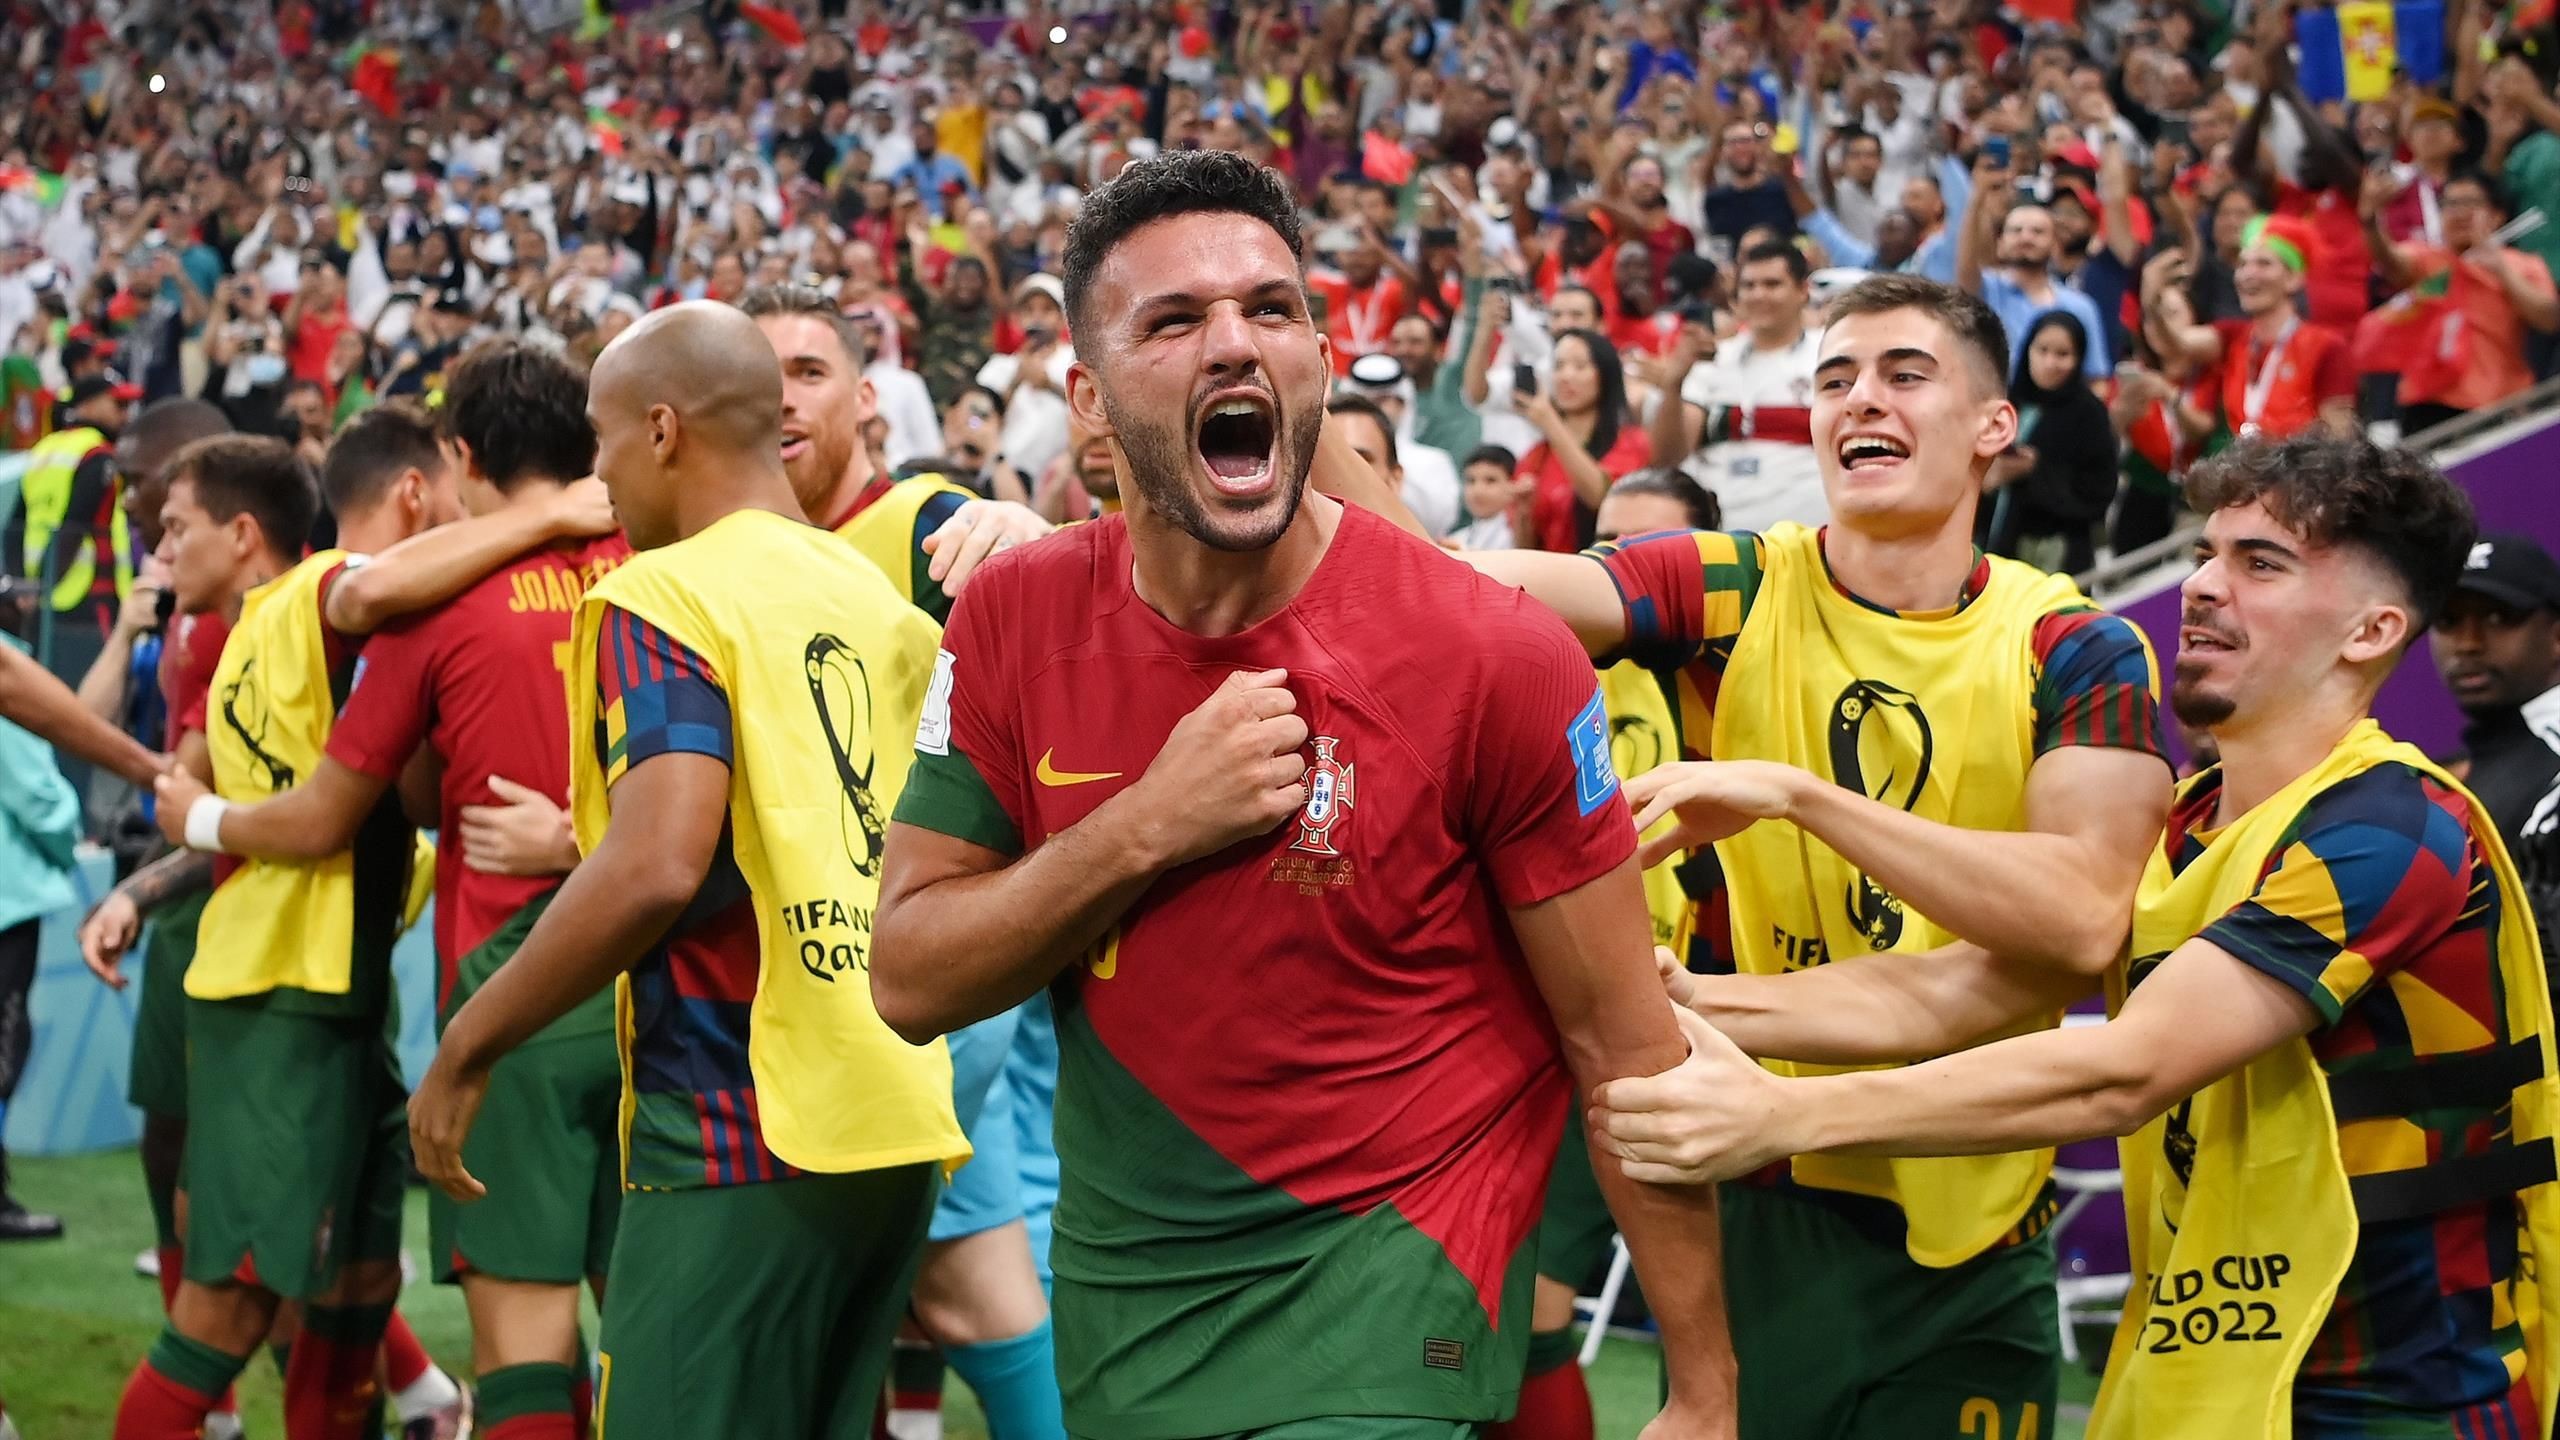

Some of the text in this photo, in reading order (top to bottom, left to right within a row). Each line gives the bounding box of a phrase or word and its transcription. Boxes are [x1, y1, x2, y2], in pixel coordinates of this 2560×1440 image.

[1271, 857, 1317, 871] ORTUGAL
[782, 899, 849, 936] FIFA
[800, 939, 869, 984] Qat
[2212, 1253, 2291, 1291] CUP
[2149, 1301, 2283, 1354] 2022
